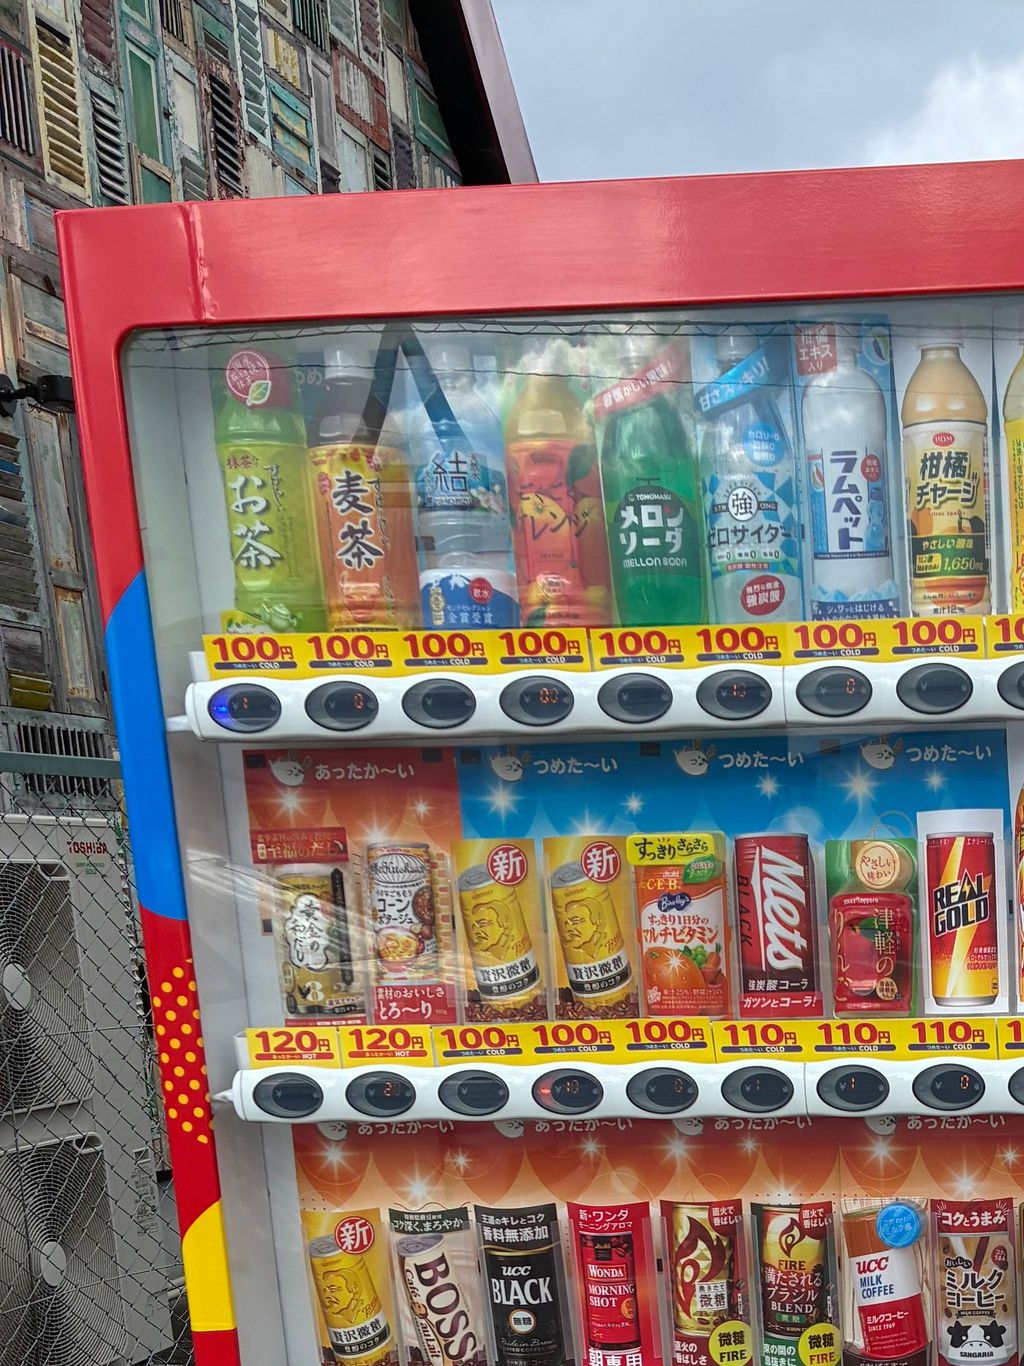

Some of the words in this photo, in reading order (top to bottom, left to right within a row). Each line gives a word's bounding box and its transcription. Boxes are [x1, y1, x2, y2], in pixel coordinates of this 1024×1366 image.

[829, 450, 864, 551] ラムペット
[916, 472, 978, 507] チャージ
[227, 474, 281, 570] お茶
[330, 470, 384, 570] 麦茶
[619, 503, 684, 530] メロン
[619, 527, 683, 555] ソーダ
[498, 631, 581, 656] 100円
[599, 630, 682, 655] 100円
[695, 627, 779, 653] 100円
[793, 624, 877, 649] 100円
[891, 619, 976, 646] 100円
[211, 636, 295, 662] 100円
[306, 635, 390, 660] 100円
[403, 633, 485, 658] 100円
[633, 840, 677, 861] すっきり
[376, 898, 411, 914] コーン
[738, 875, 753, 948] BLACK
[761, 844, 808, 973] Mets
[934, 897, 990, 937] GOLD
[647, 914, 709, 927] すっきり1日分の
[642, 926, 719, 945] マルチビタミン
[743, 995, 817, 1009] ガツンとコーラ!
[255, 1030, 331, 1052] 120円
[348, 1027, 424, 1050] 120円
[440, 1027, 520, 1050] 100円
[532, 1024, 612, 1046] 100円
[625, 1020, 705, 1043] 100円
[723, 1024, 797, 1046] 110円
[816, 1022, 891, 1045] 110円
[911, 1021, 986, 1043] 110円
[481, 1213, 545, 1227] 王道のキレとコク
[941, 1210, 1006, 1226] コクとうまみ
[482, 1226, 549, 1242] 香料無添加
[587, 1264, 624, 1278] WONDA
[764, 1266, 823, 1286] 満たされる
[777, 1260, 806, 1270] FIRE
[490, 1276, 553, 1306] BLACK
[588, 1283, 635, 1296] MORNING
[859, 1275, 882, 1288] MILK
[946, 1269, 1005, 1291] ミルク
[589, 1296, 617, 1308] SHOT
[698, 1292, 727, 1309] 微糖
[766, 1287, 819, 1301] ブラジル
[861, 1284, 895, 1300] COFFEE
[946, 1290, 1006, 1308] コーヒー
[413, 1251, 478, 1361] BOSS
[771, 1301, 813, 1314] BLEND
[866, 1311, 909, 1325] ミルクコーヒー
[717, 1330, 745, 1347] 微糖
[808, 1332, 834, 1349] 微糖
[718, 1349, 747, 1362] FIRE
[808, 1353, 836, 1365] FIRE
[959, 1350, 994, 1358] SANGARIA
